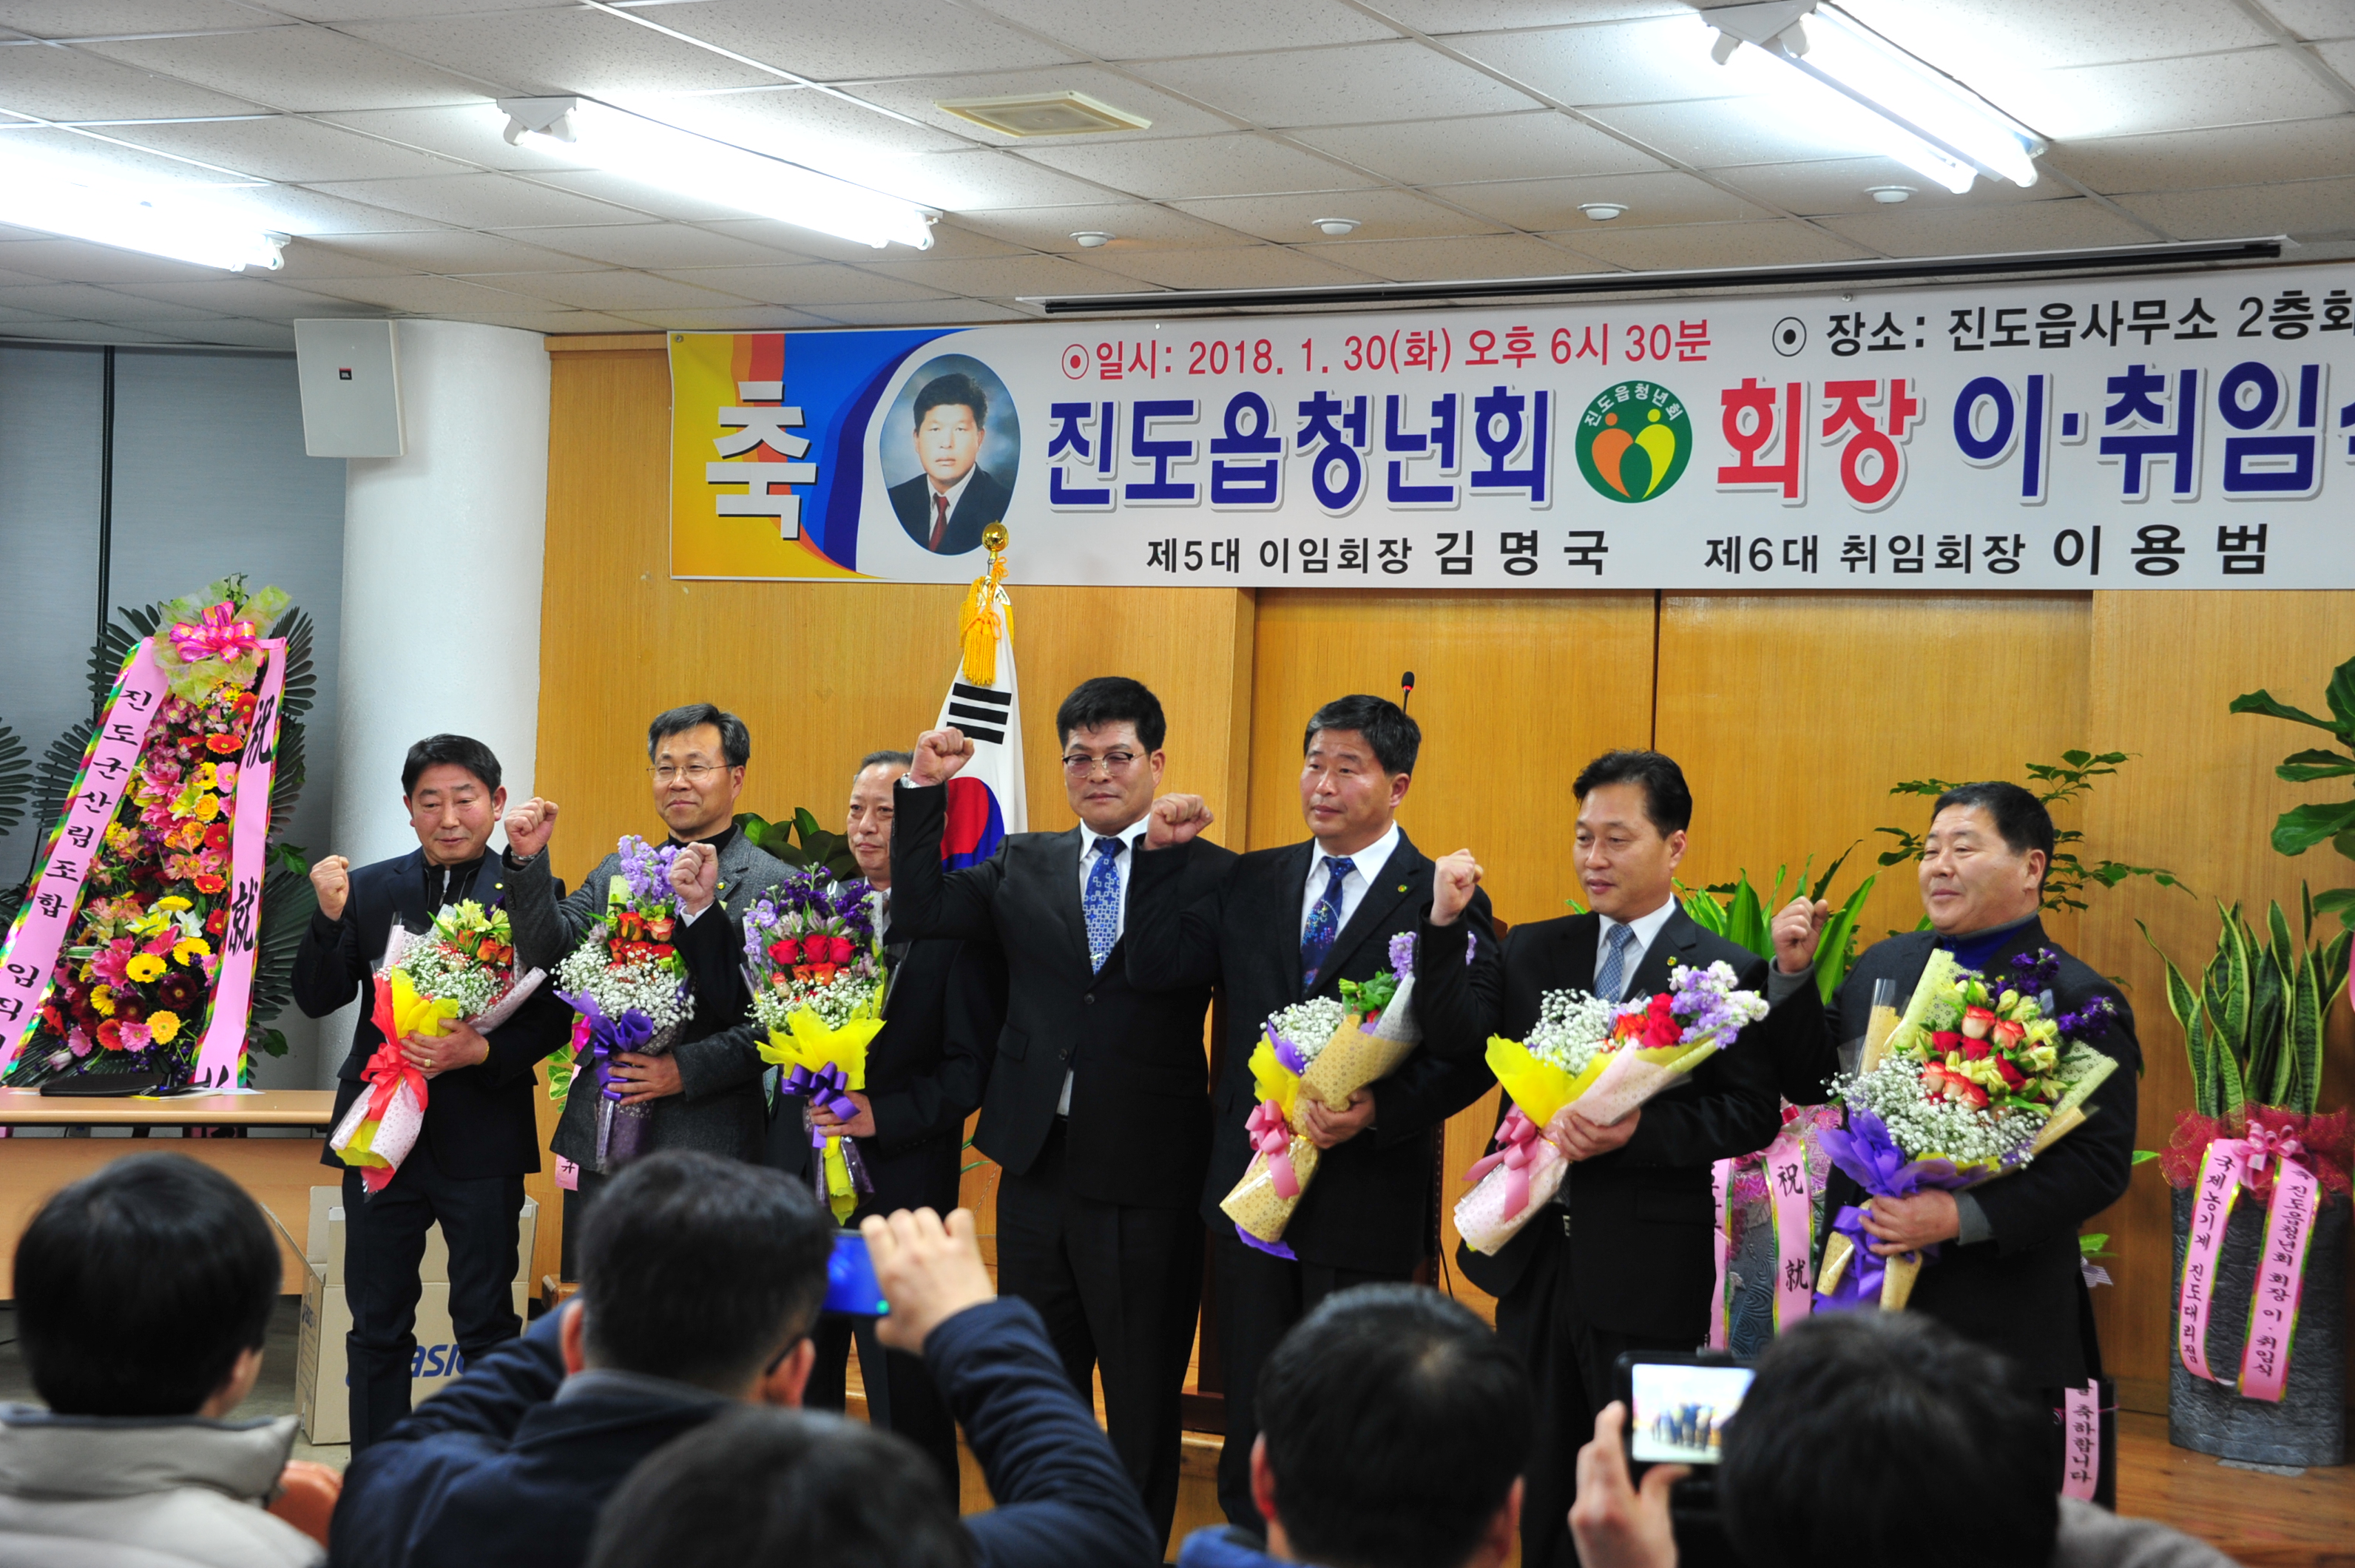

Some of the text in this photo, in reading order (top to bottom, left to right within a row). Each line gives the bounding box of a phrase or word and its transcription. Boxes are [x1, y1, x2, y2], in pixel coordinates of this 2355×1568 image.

[1097, 320, 1712, 380] 일시: 2018. 1. 30(화) 오후 6시 30분
[1827, 311, 1925, 356] 장소:
[1947, 297, 2218, 351] 진도읍사무소
[1047, 361, 2355, 512] 진도읍청년회 회장 이·취임
[1584, 383, 1683, 427] 진도읍청년회
[705, 380, 818, 541] 축
[1146, 538, 1240, 573] 제5대
[1260, 537, 1413, 575] 이임회장
[1705, 535, 1819, 574] 제6대
[1840, 533, 2027, 575] 취임회장
[0, 689, 152, 1050] 진도군산림조합 임직
[2194, 1155, 2235, 1251] 국제농기계
[2070, 1403, 2095, 1483] 축하합니다
